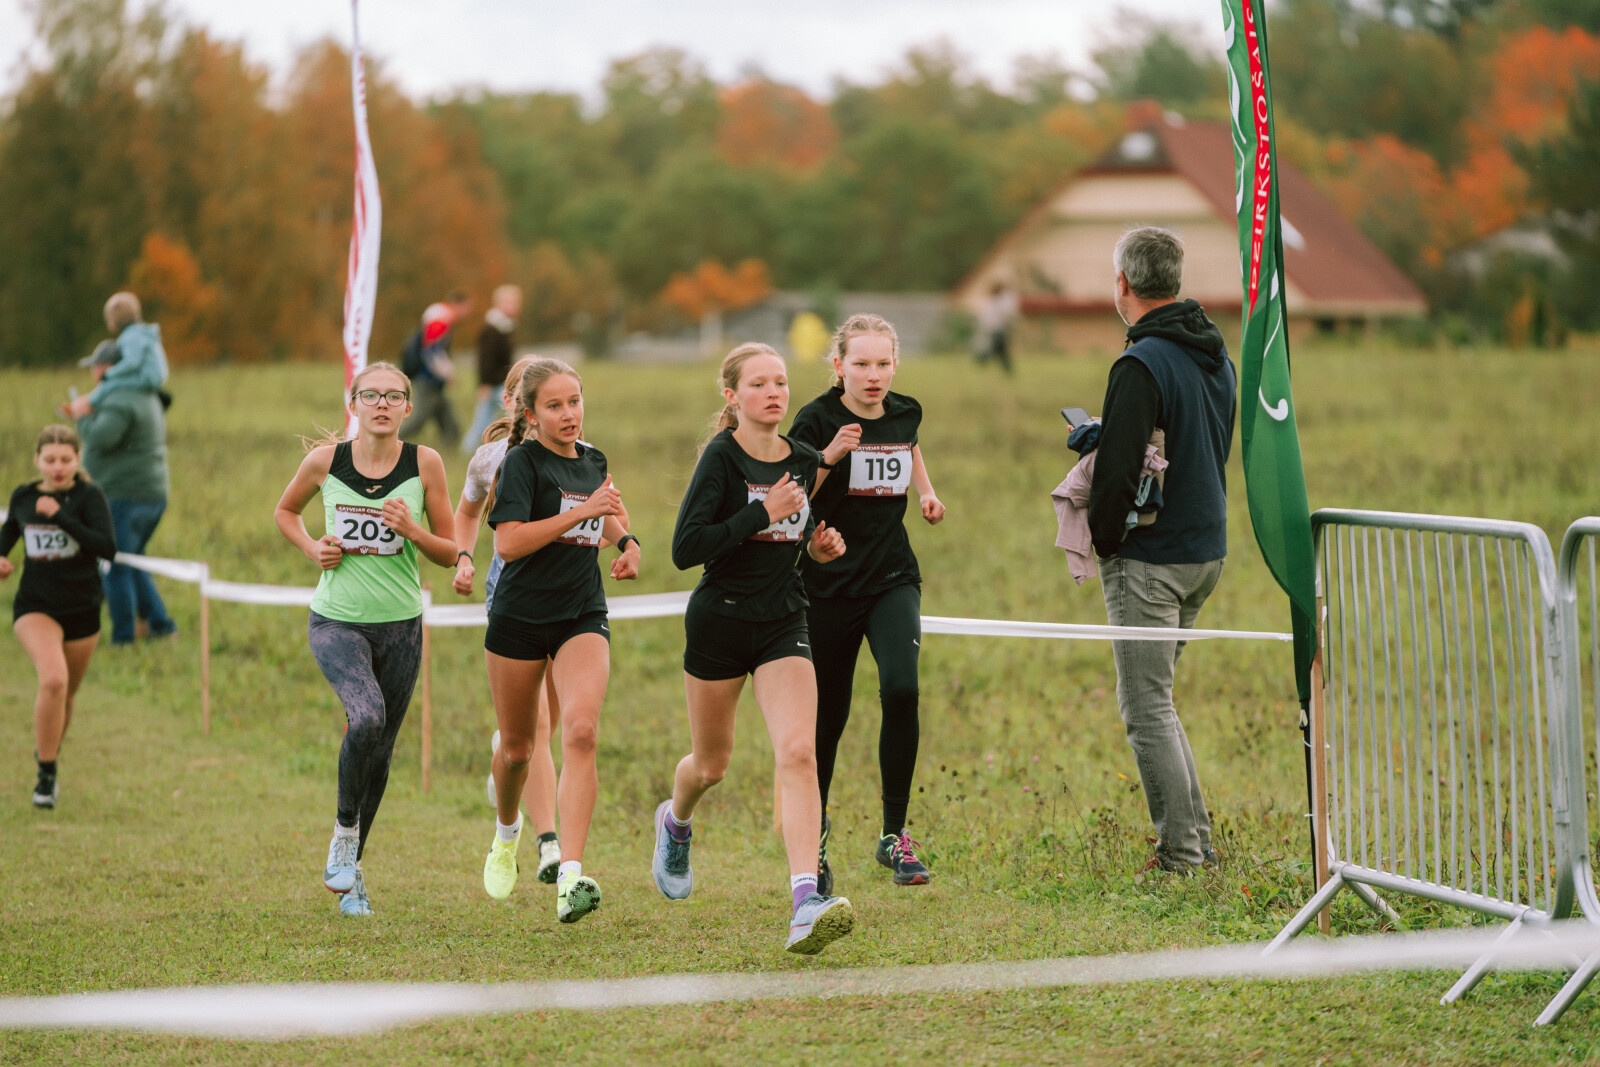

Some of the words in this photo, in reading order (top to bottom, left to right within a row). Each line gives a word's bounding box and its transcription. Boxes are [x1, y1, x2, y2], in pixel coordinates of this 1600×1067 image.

[865, 457, 902, 481] 119
[34, 532, 68, 550] 129
[342, 518, 396, 543] 203
